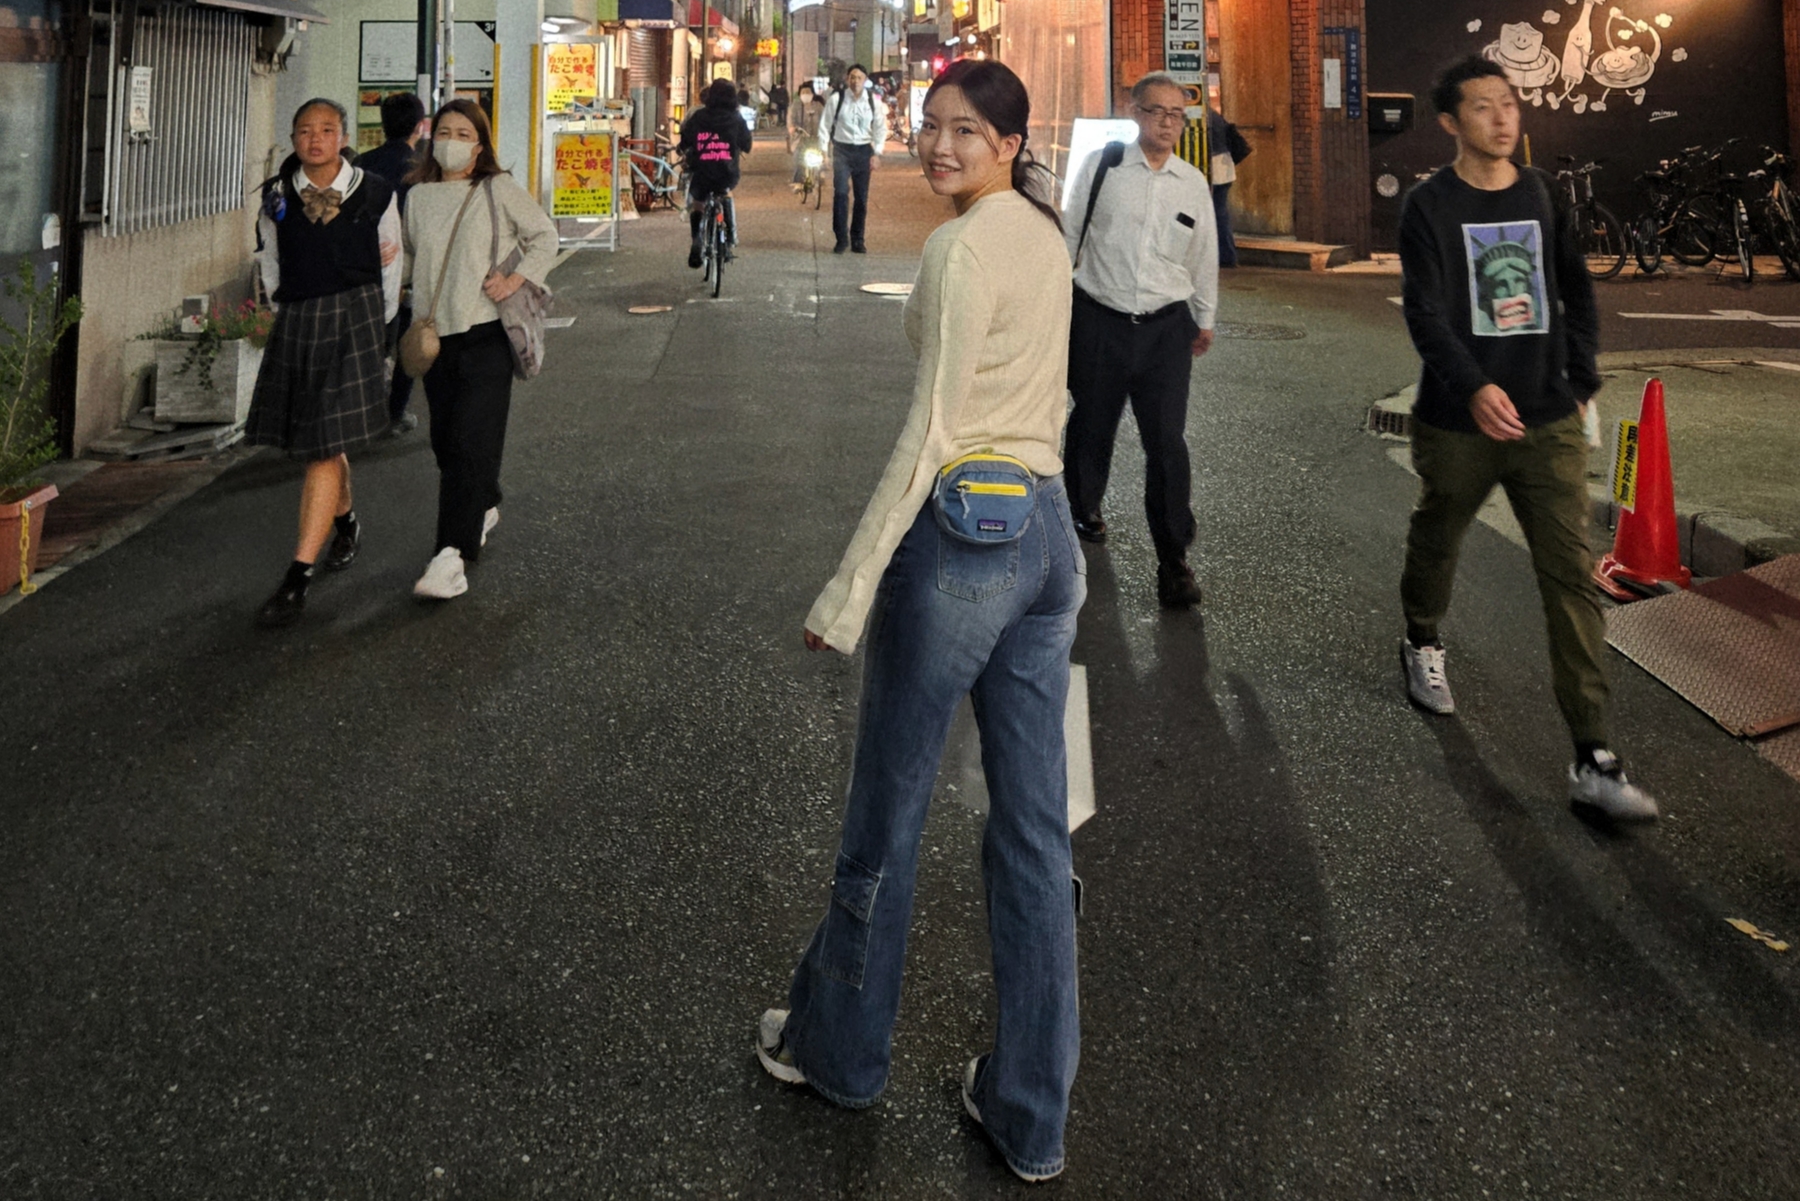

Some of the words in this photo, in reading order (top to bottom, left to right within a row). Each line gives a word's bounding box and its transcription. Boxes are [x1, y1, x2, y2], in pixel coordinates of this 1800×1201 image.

[550, 64, 596, 76] たこ焼き
[556, 158, 612, 172] たこ焼き
